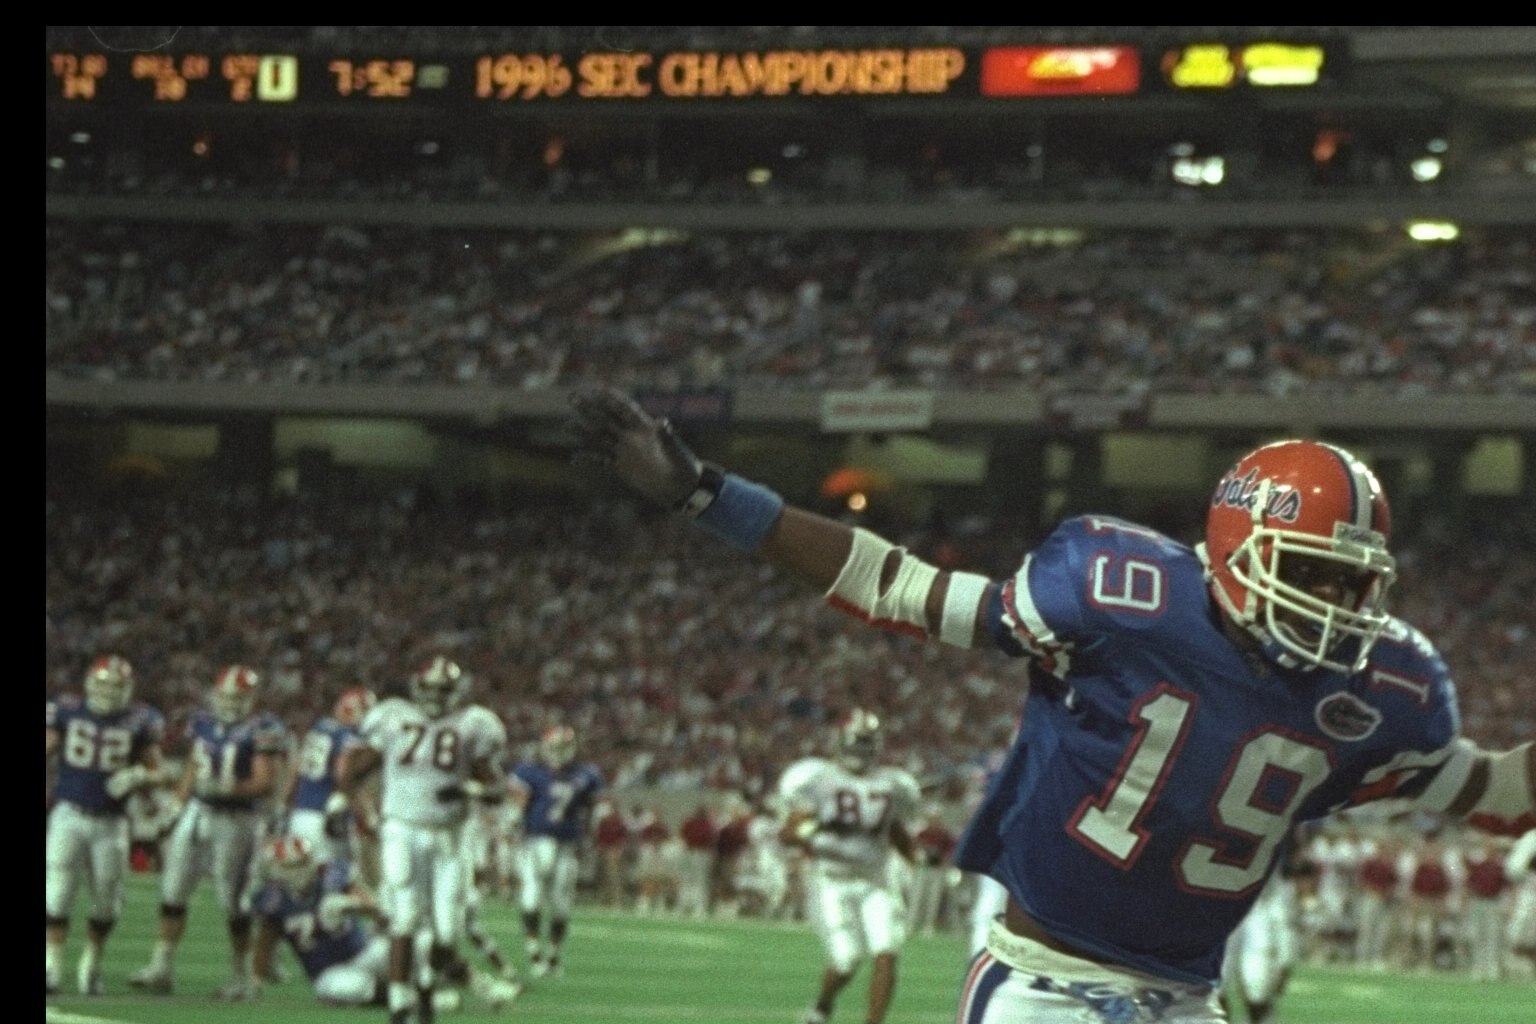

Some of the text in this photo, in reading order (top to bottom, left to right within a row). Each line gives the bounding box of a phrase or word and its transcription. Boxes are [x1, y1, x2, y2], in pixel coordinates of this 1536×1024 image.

[328, 60, 415, 97] 7:52
[476, 48, 967, 100] 1996 SEC CHAMPIONSHIP
[63, 716, 132, 772] 62
[399, 722, 458, 771] 78
[1066, 682, 1336, 898] 19
